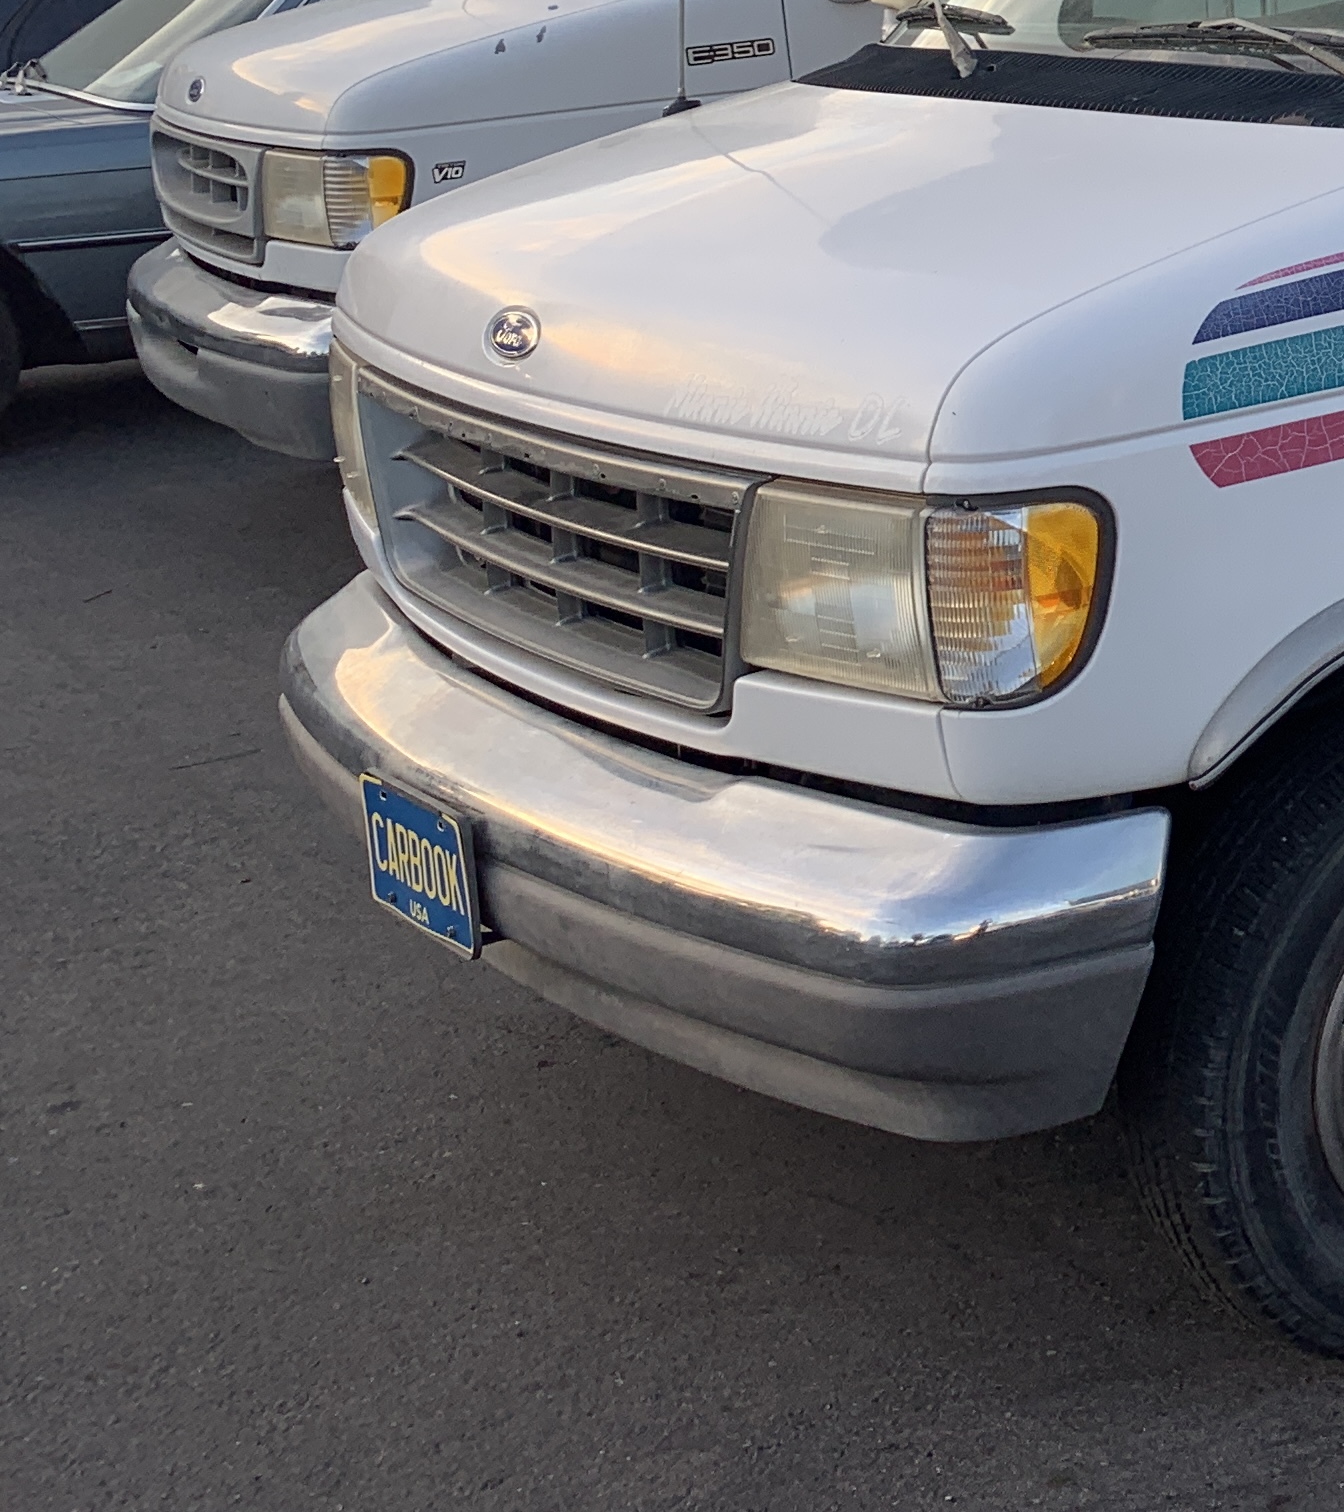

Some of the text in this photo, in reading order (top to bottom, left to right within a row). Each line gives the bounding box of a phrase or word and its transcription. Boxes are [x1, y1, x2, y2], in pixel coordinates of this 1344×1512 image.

[433, 166, 464, 183] V10
[371, 811, 465, 916] CARBOOK
[409, 898, 430, 925] USA
